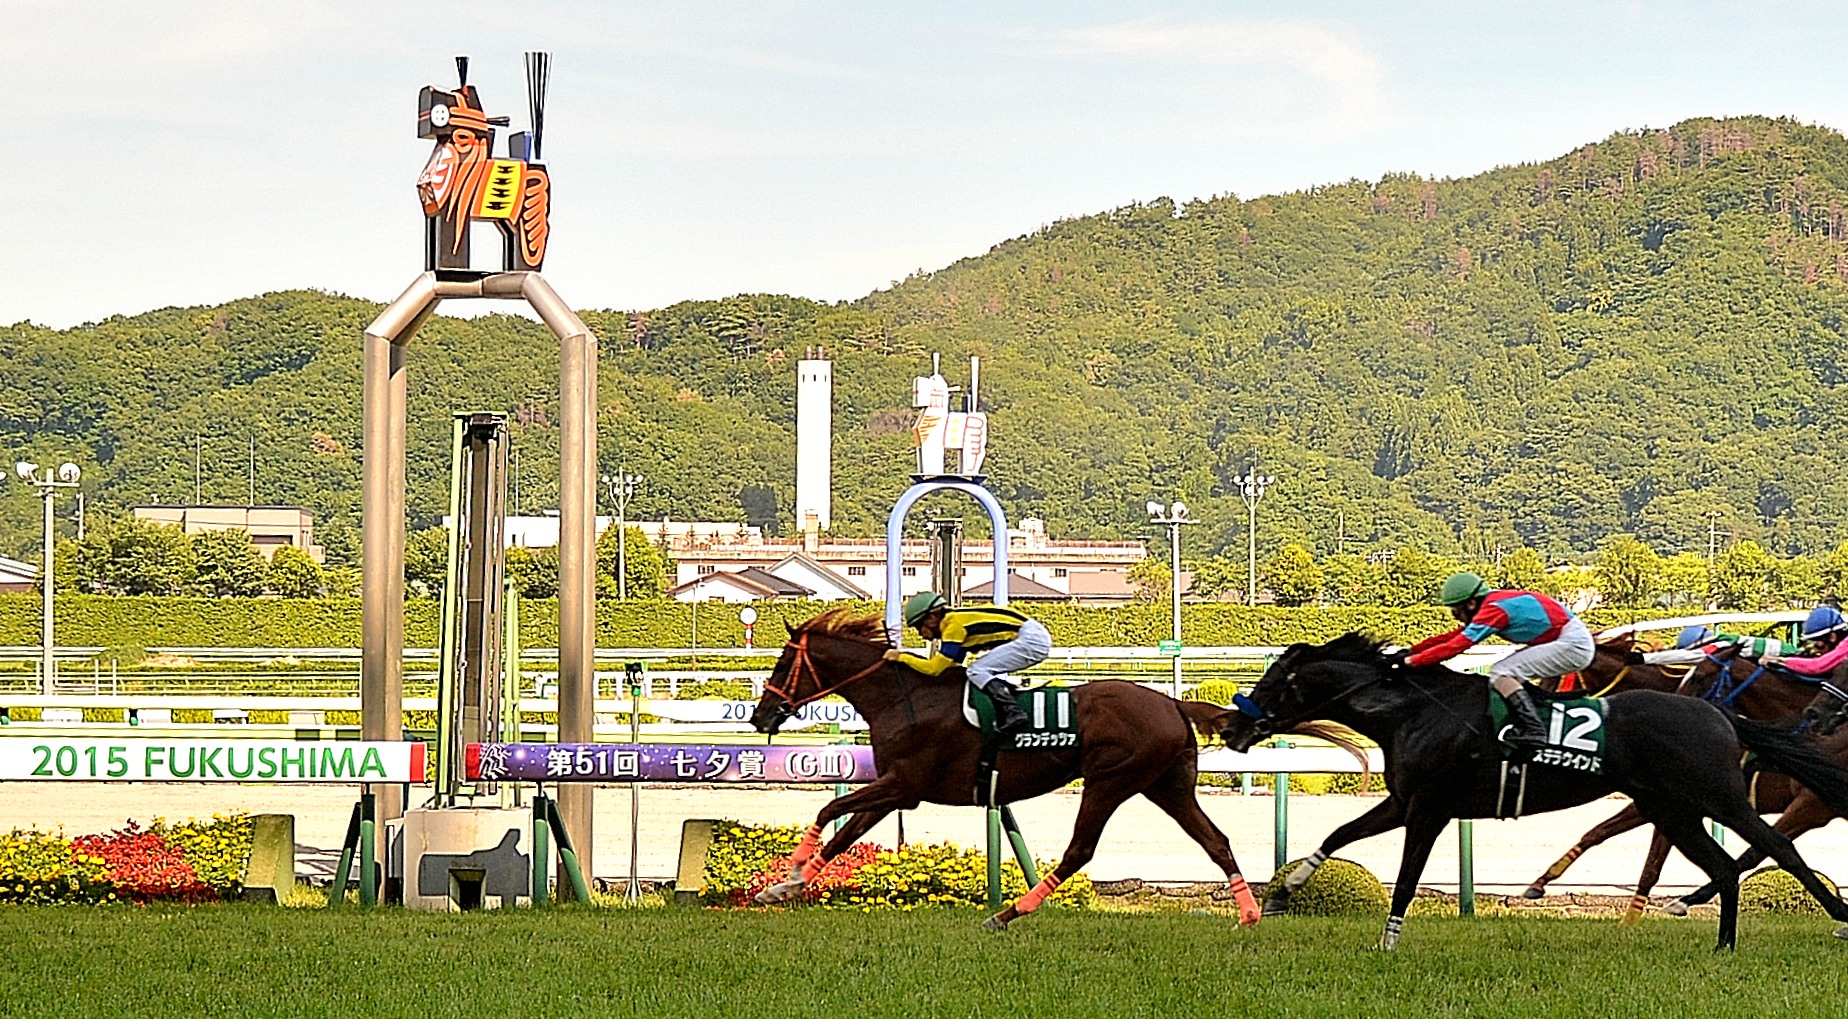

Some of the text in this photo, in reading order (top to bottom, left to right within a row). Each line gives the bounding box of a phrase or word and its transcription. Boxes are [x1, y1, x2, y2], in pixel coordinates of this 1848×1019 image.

[1033, 691, 1070, 728] 11
[1548, 703, 1602, 751] 12
[31, 745, 388, 778] 2015 FUKUSHIMA
[546, 749, 640, 777] 第51回
[669, 750, 766, 779] 七夕賞
